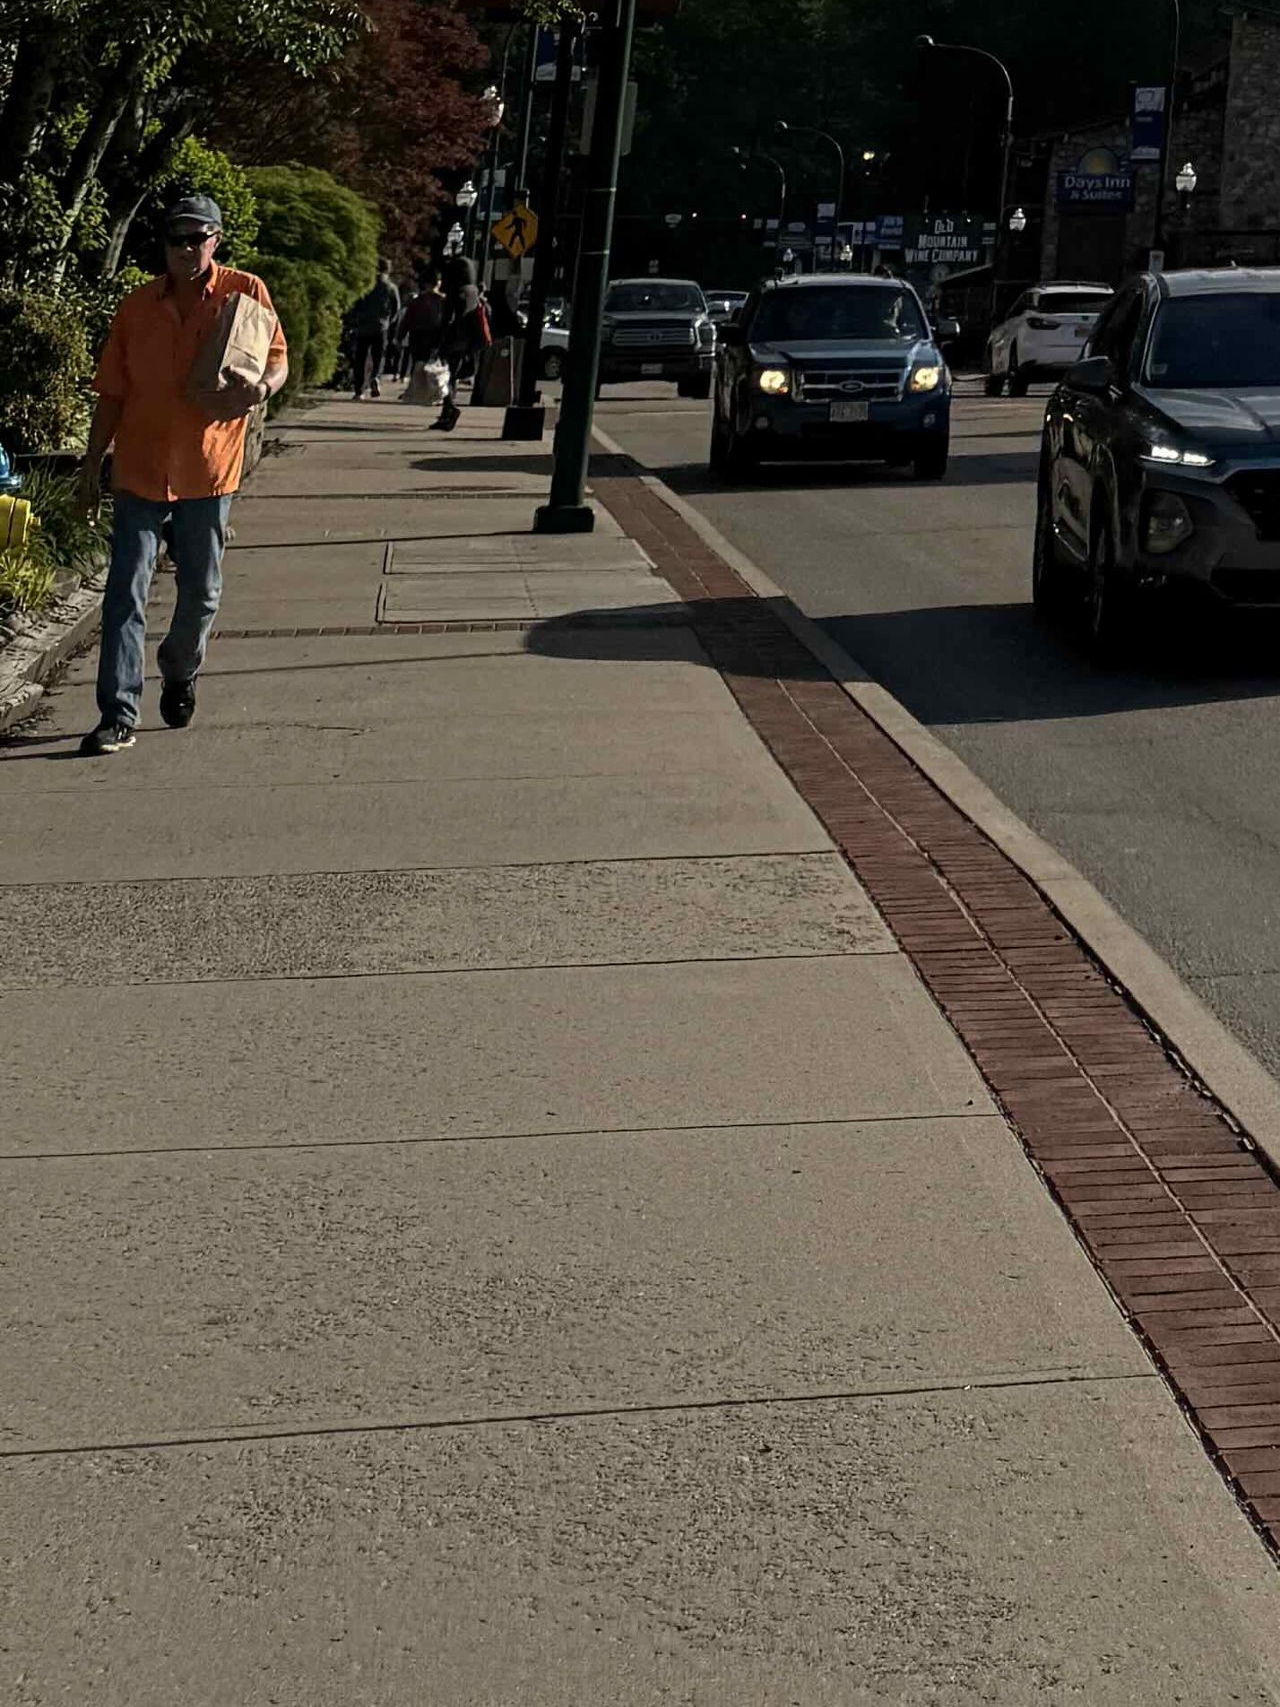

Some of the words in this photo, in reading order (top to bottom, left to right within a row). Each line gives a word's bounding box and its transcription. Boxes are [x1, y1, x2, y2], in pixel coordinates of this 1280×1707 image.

[1063, 175, 1104, 191] Days
[1104, 175, 1131, 189] Inn
[917, 234, 969, 249] MOUNTAIN
[904, 248, 930, 263] WINE
[931, 248, 978, 263] COMPANY
